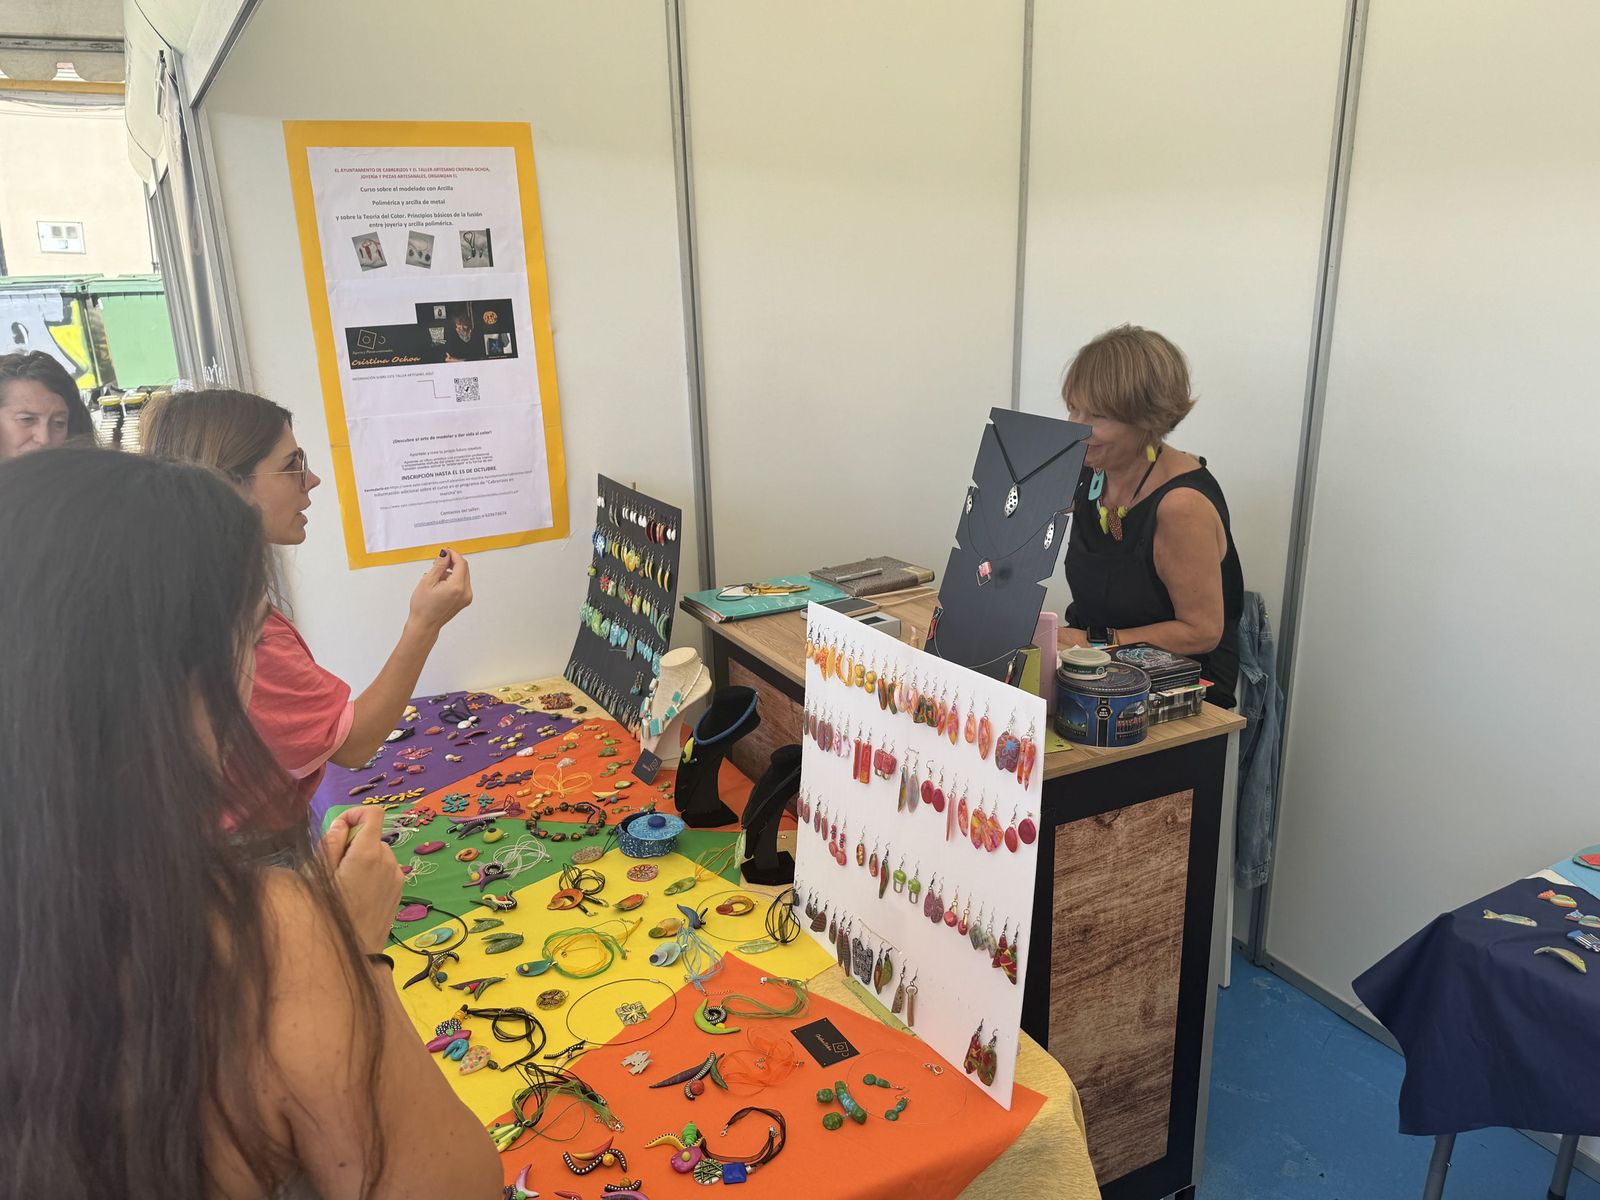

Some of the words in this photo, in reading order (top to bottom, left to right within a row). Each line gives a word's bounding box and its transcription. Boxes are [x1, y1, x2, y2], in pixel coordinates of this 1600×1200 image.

[351, 357, 390, 366] Cristina
[391, 354, 421, 363] Ochoa
[401, 472, 434, 481] INSCRIPCIÓN
